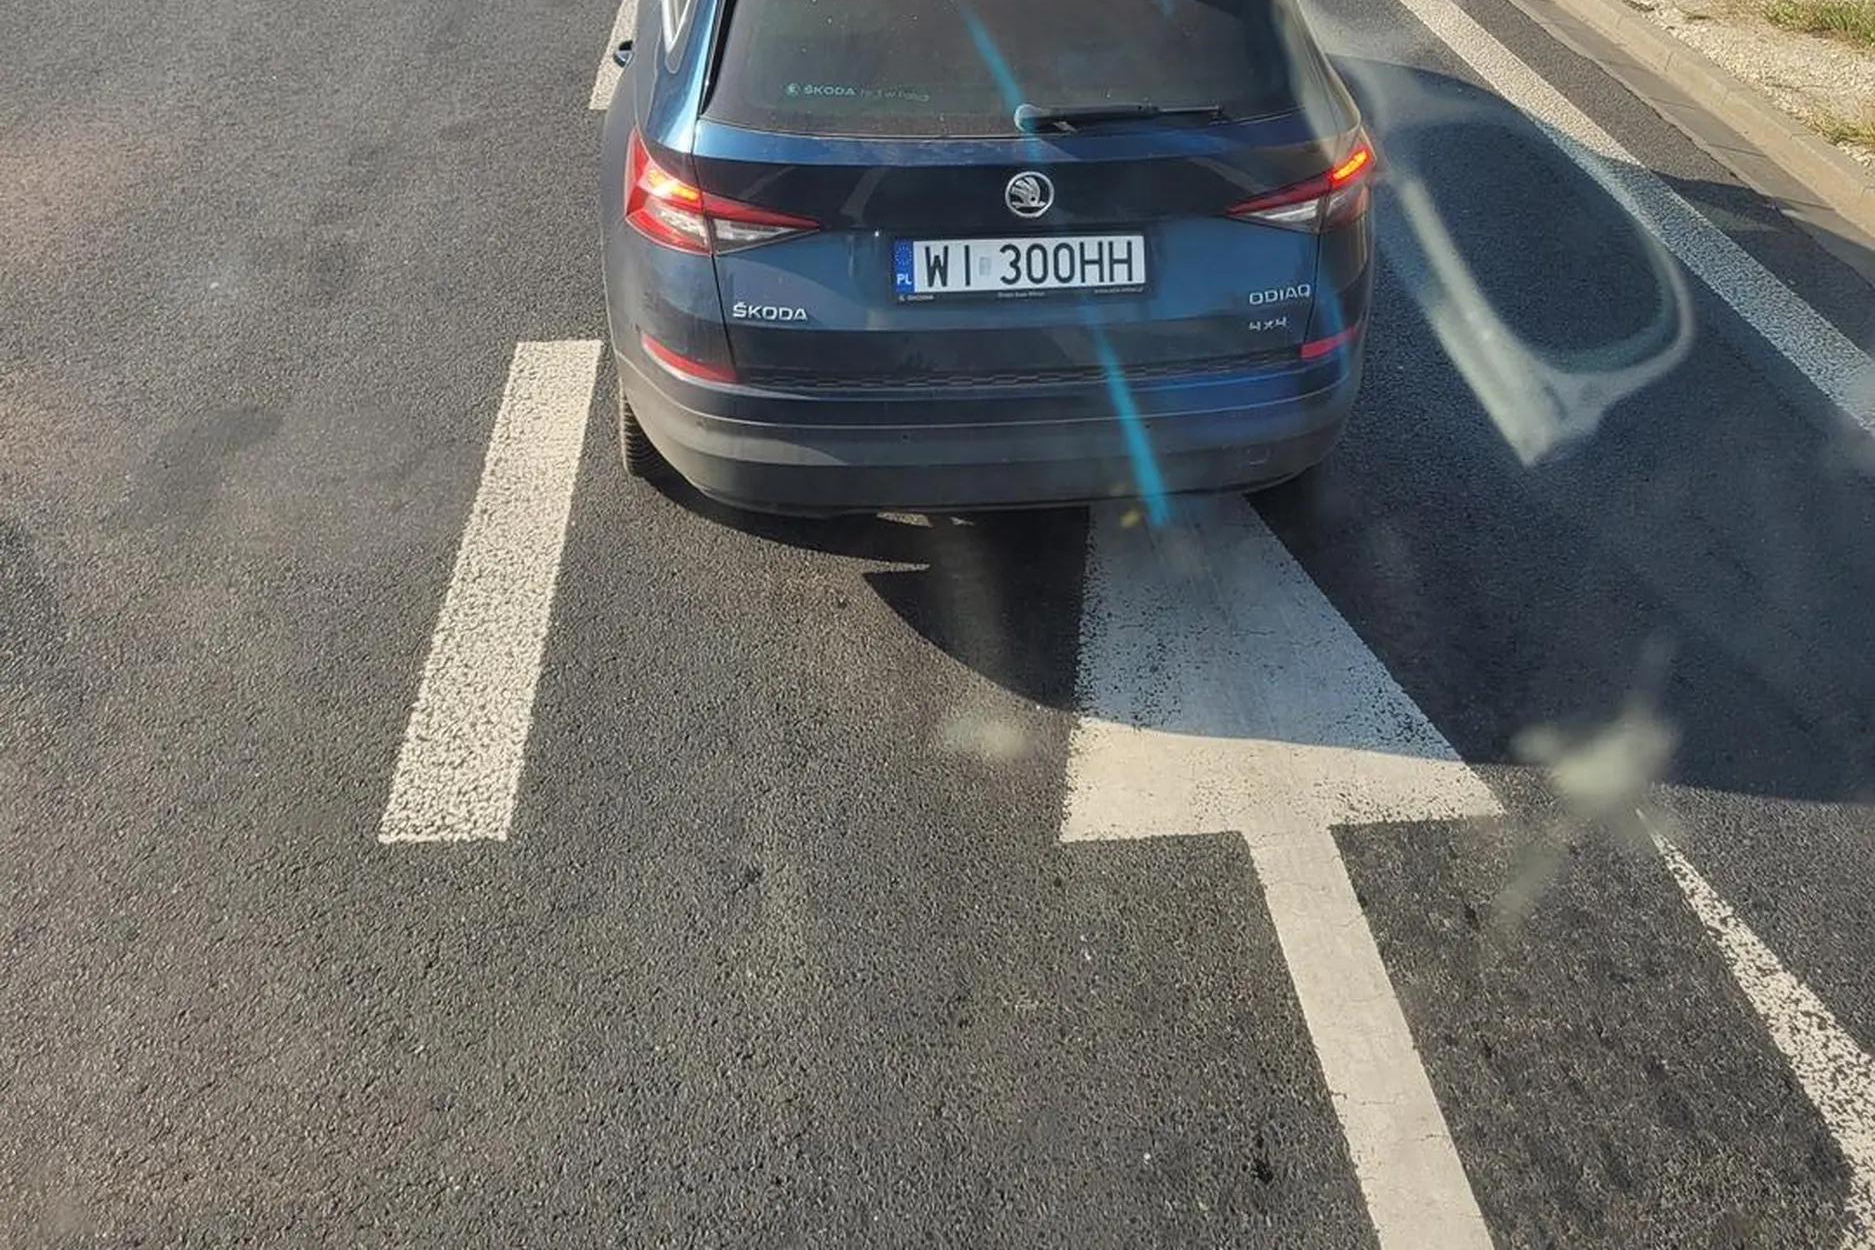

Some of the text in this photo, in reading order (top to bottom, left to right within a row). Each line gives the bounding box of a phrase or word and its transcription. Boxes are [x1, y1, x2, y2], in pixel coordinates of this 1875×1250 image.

[924, 240, 1134, 288] WI 300HH
[896, 273, 913, 286] PL
[732, 300, 808, 321] ŠKODA
